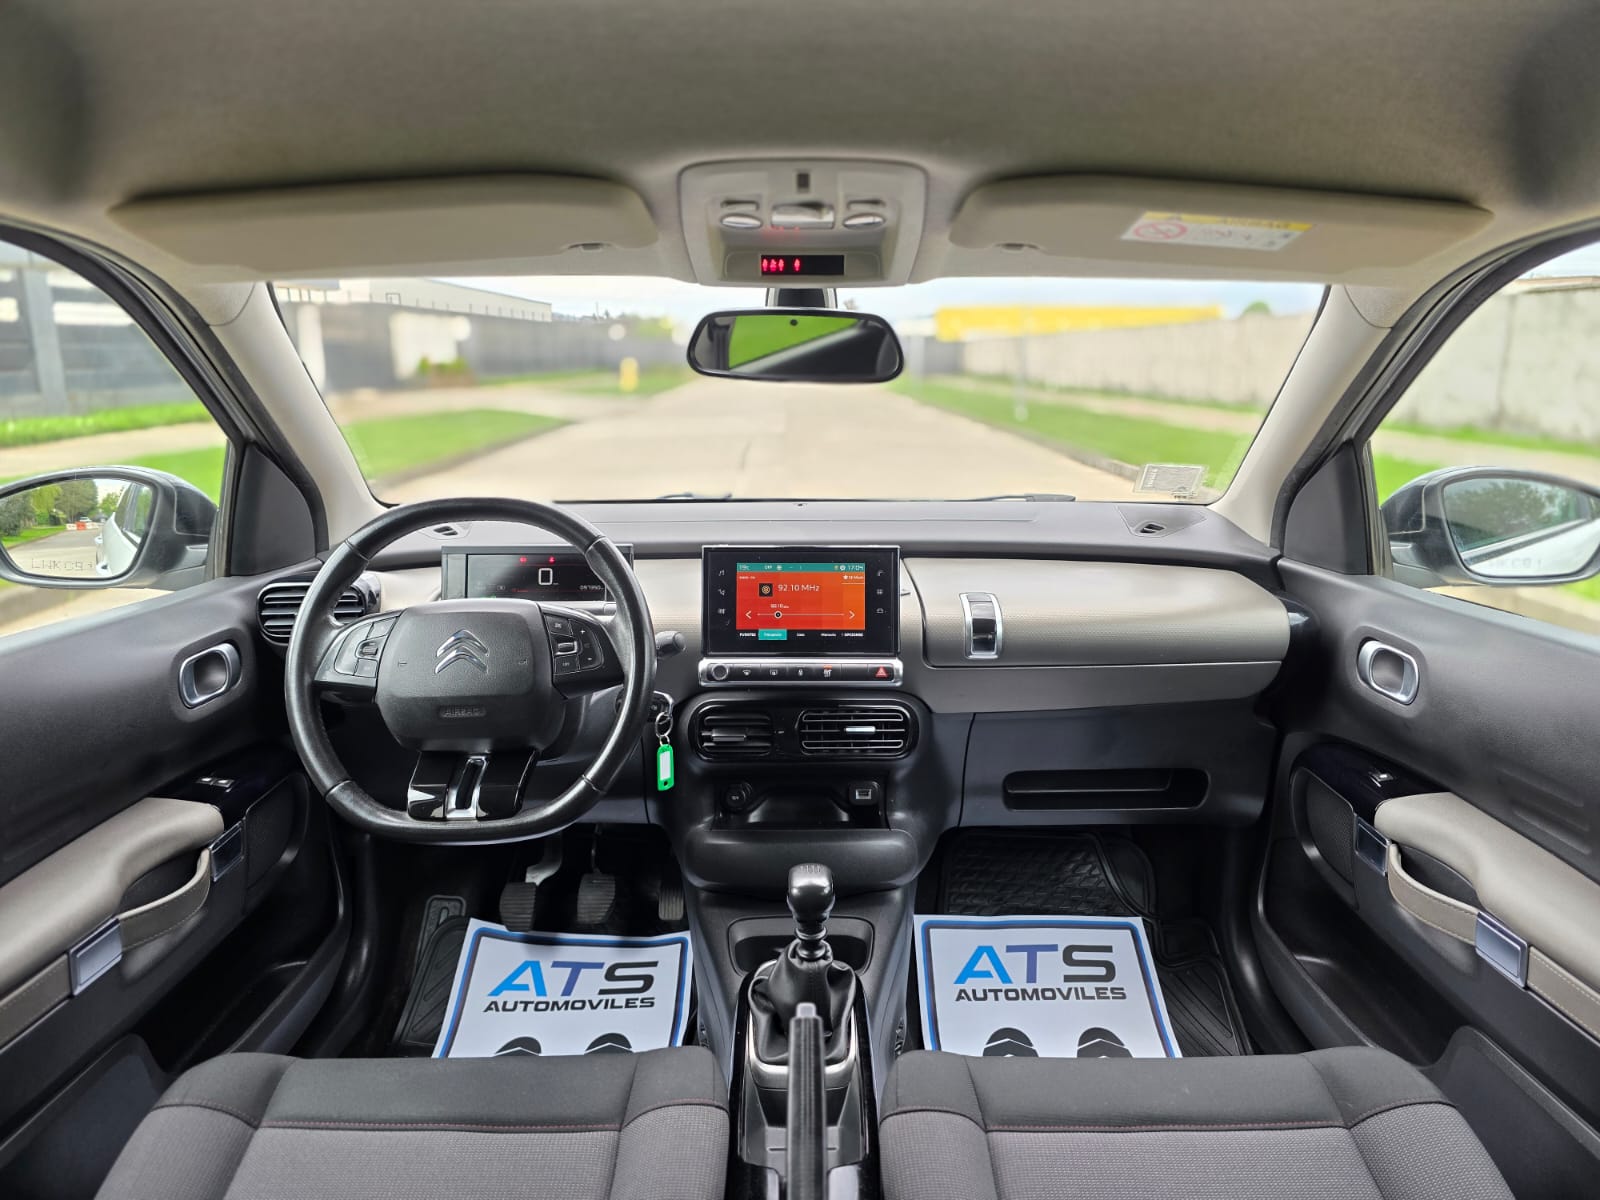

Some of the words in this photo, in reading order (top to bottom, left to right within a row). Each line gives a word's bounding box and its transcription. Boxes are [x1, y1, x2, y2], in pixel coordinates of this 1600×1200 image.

[538, 567, 553, 586] 0
[778, 584, 800, 592] 92.10
[801, 584, 820, 592] MHz
[953, 944, 1117, 985] ATS
[487, 960, 659, 997] ATS
[955, 986, 1127, 1002] AUTOMOVILES
[483, 997, 656, 1013] AUTOMOVILES
